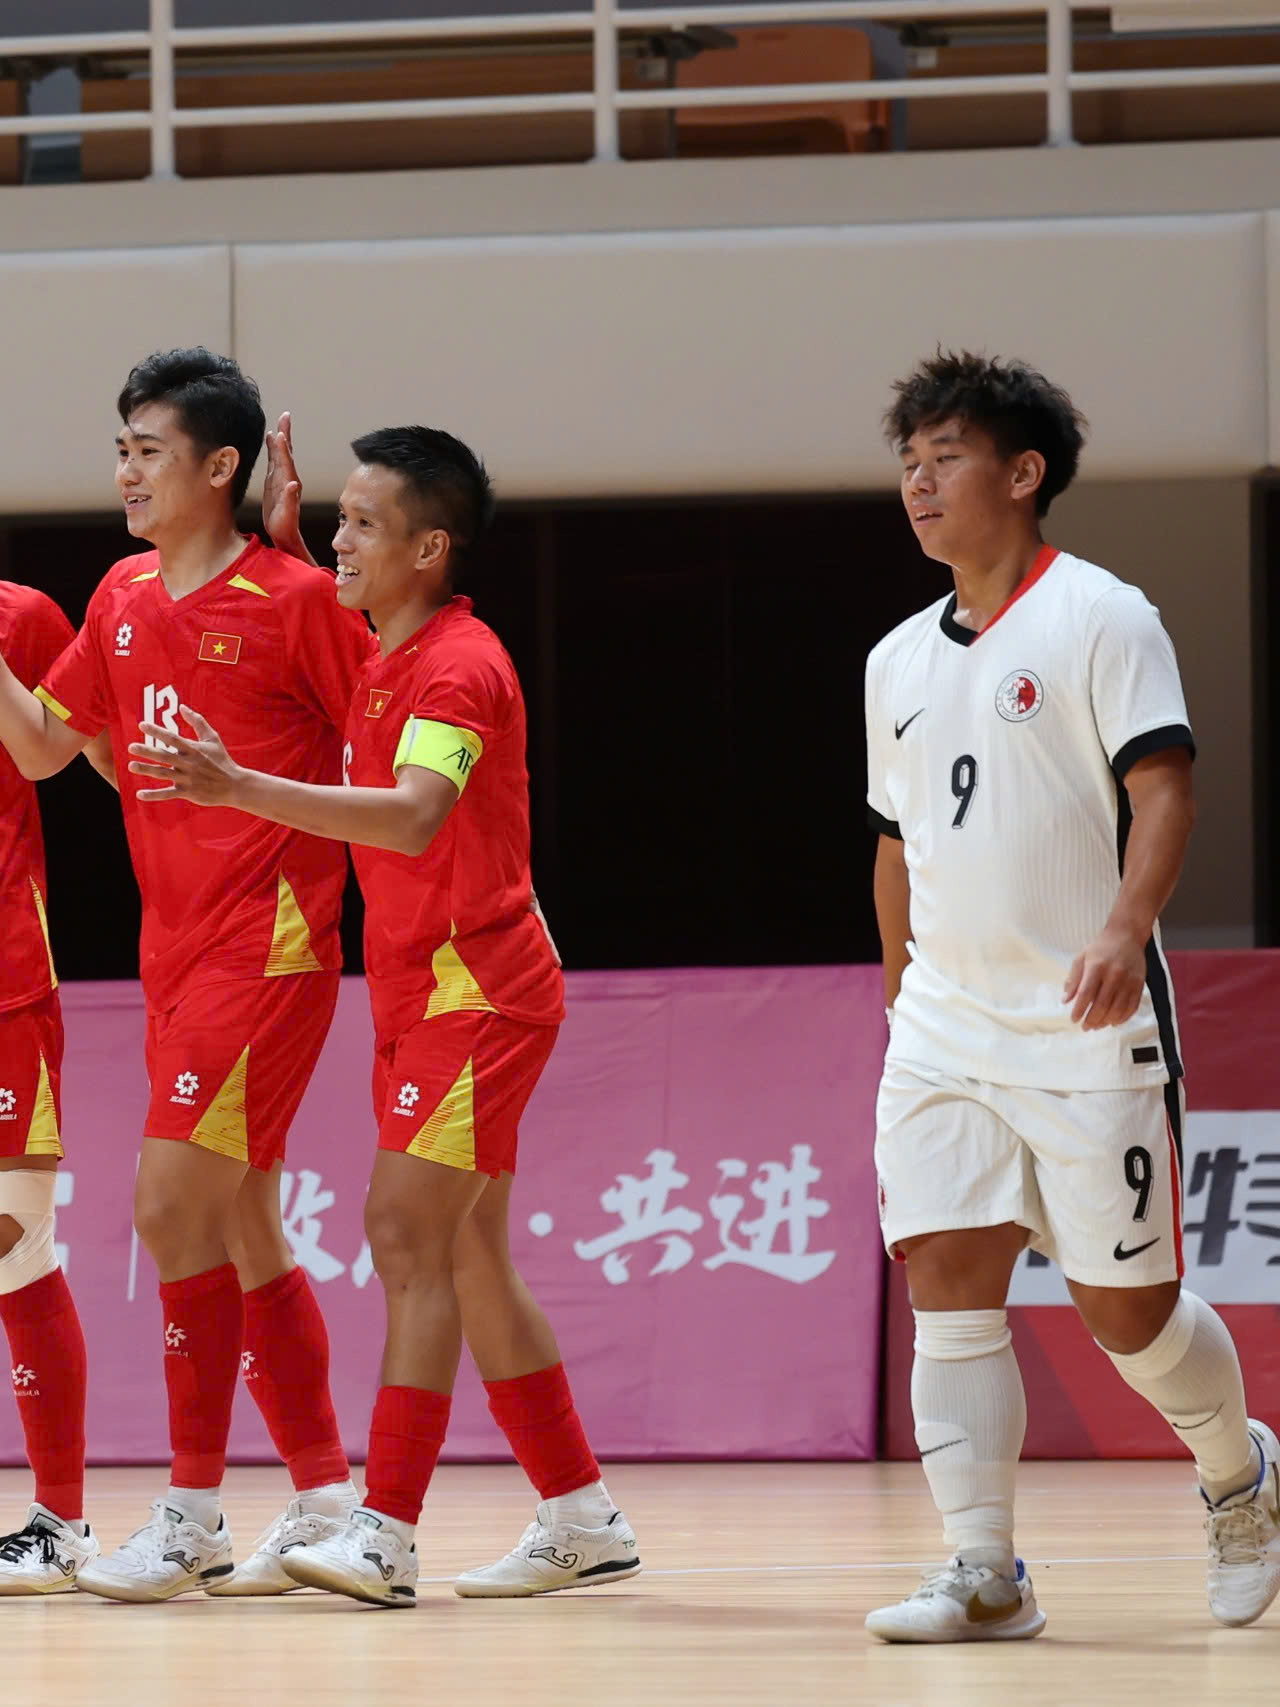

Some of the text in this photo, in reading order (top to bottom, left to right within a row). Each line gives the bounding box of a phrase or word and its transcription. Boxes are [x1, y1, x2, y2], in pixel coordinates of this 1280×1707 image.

[143, 683, 179, 754] 13
[951, 754, 979, 830] 9
[1124, 1145, 1155, 1223] 9
